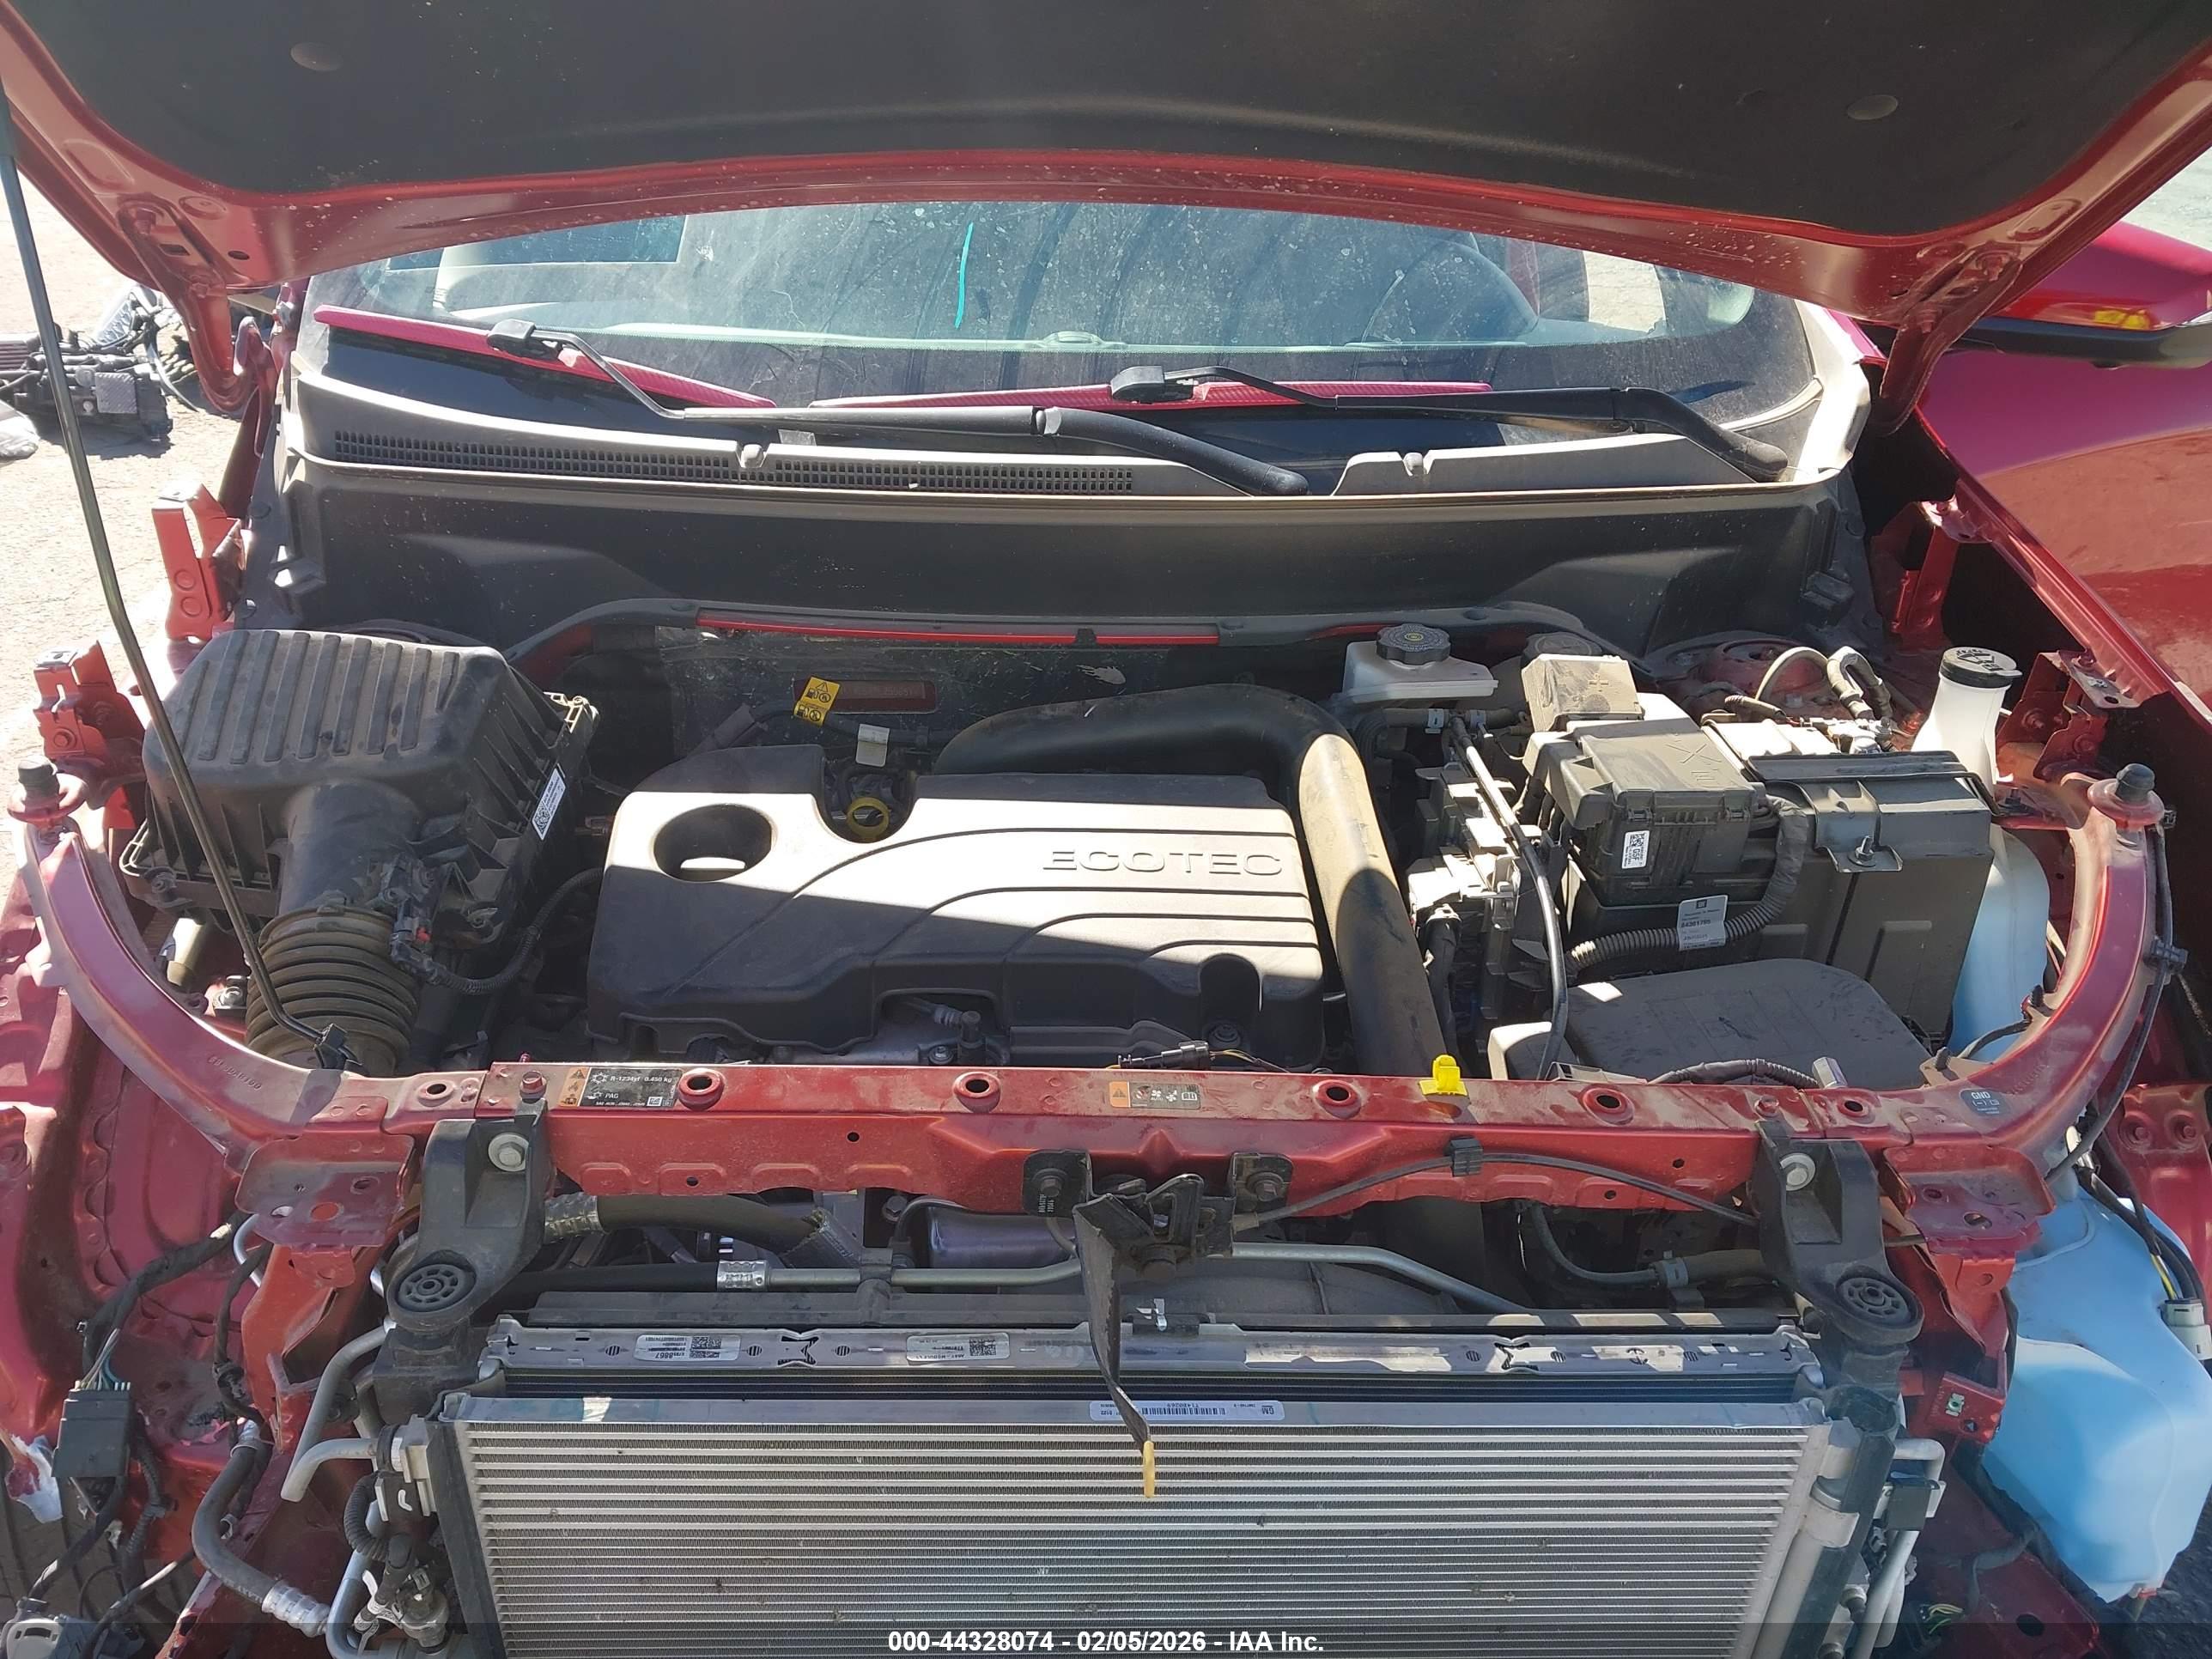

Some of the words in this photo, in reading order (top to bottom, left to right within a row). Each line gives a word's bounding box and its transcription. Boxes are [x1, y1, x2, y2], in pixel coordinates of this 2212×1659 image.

[1042, 850, 1283, 876] ECOTEC
[1971, 1091, 1991, 1100] GND
[1261, 1406, 1275, 1414] GM
